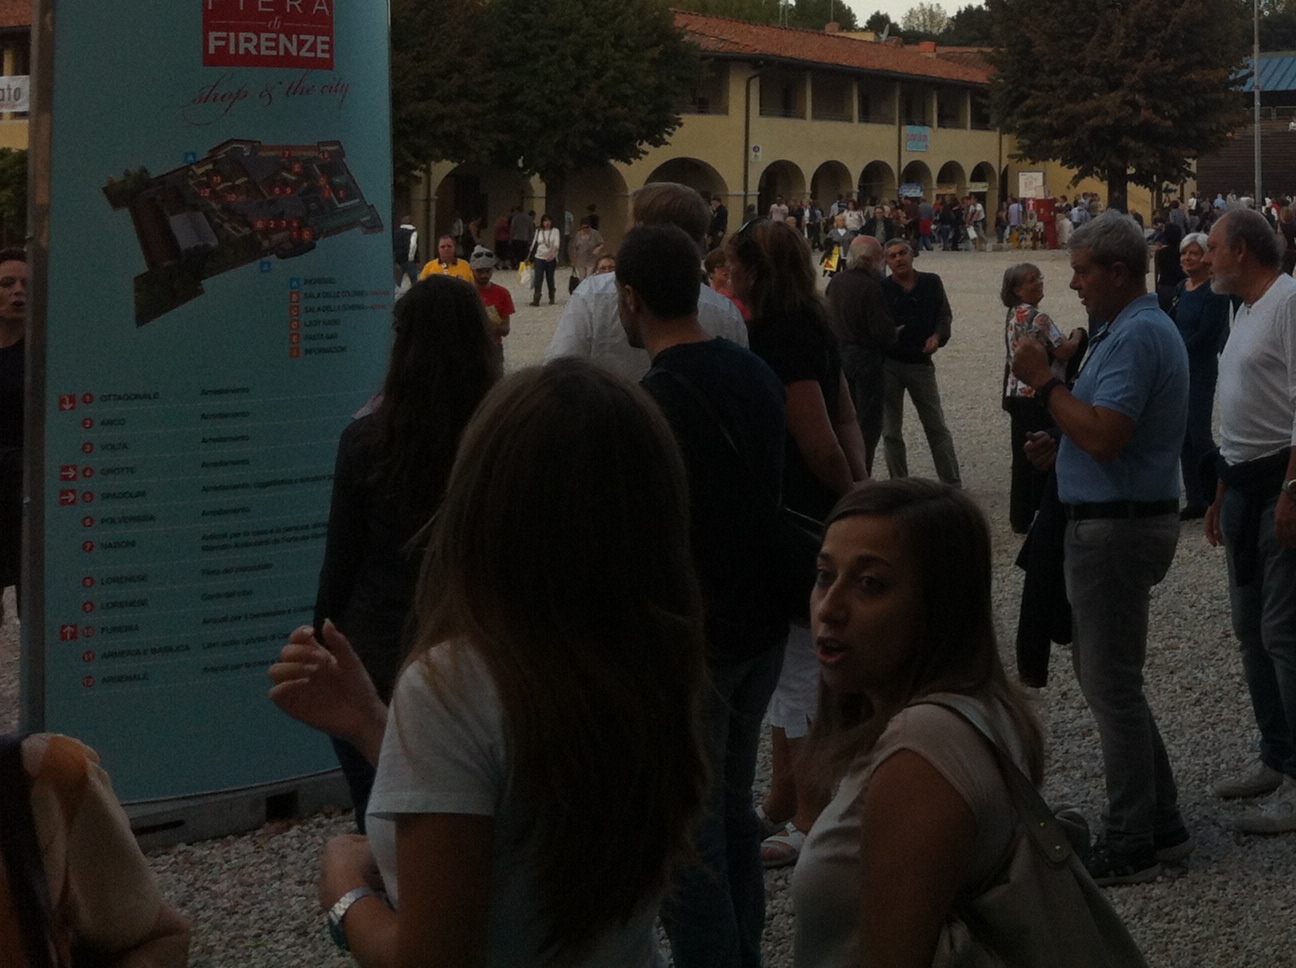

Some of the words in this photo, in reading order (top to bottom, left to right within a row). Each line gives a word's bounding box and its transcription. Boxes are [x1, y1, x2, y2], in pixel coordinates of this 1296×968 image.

[267, 16, 282, 29] di
[208, 31, 331, 59] FIRENZE
[181, 72, 250, 126] shop
[259, 81, 284, 107] &
[286, 70, 316, 97] the
[320, 77, 351, 110] city
[101, 392, 159, 402] OTTAGONALE
